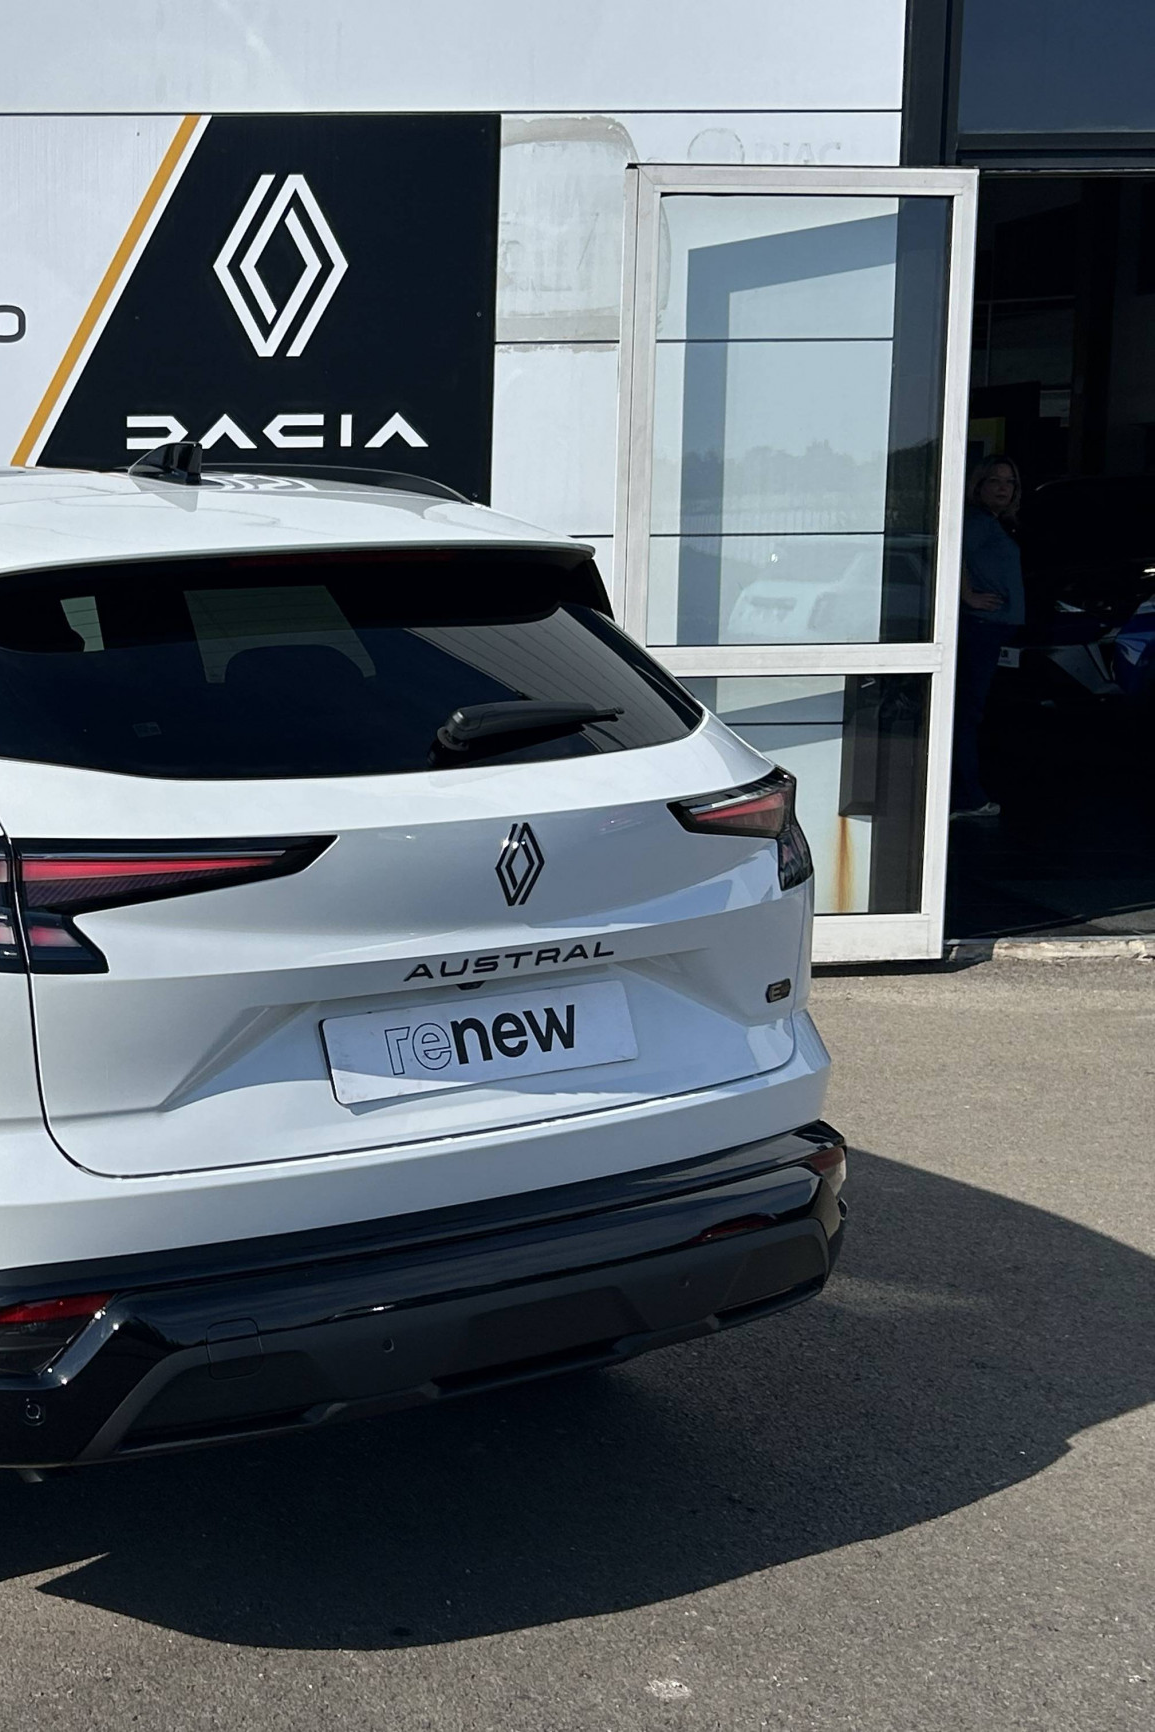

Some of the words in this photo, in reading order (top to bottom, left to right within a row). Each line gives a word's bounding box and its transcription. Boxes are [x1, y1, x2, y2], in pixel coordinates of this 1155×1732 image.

[126, 412, 429, 450] DACIA
[403, 942, 614, 982] AUSTRAL
[384, 1004, 575, 1076] renew
